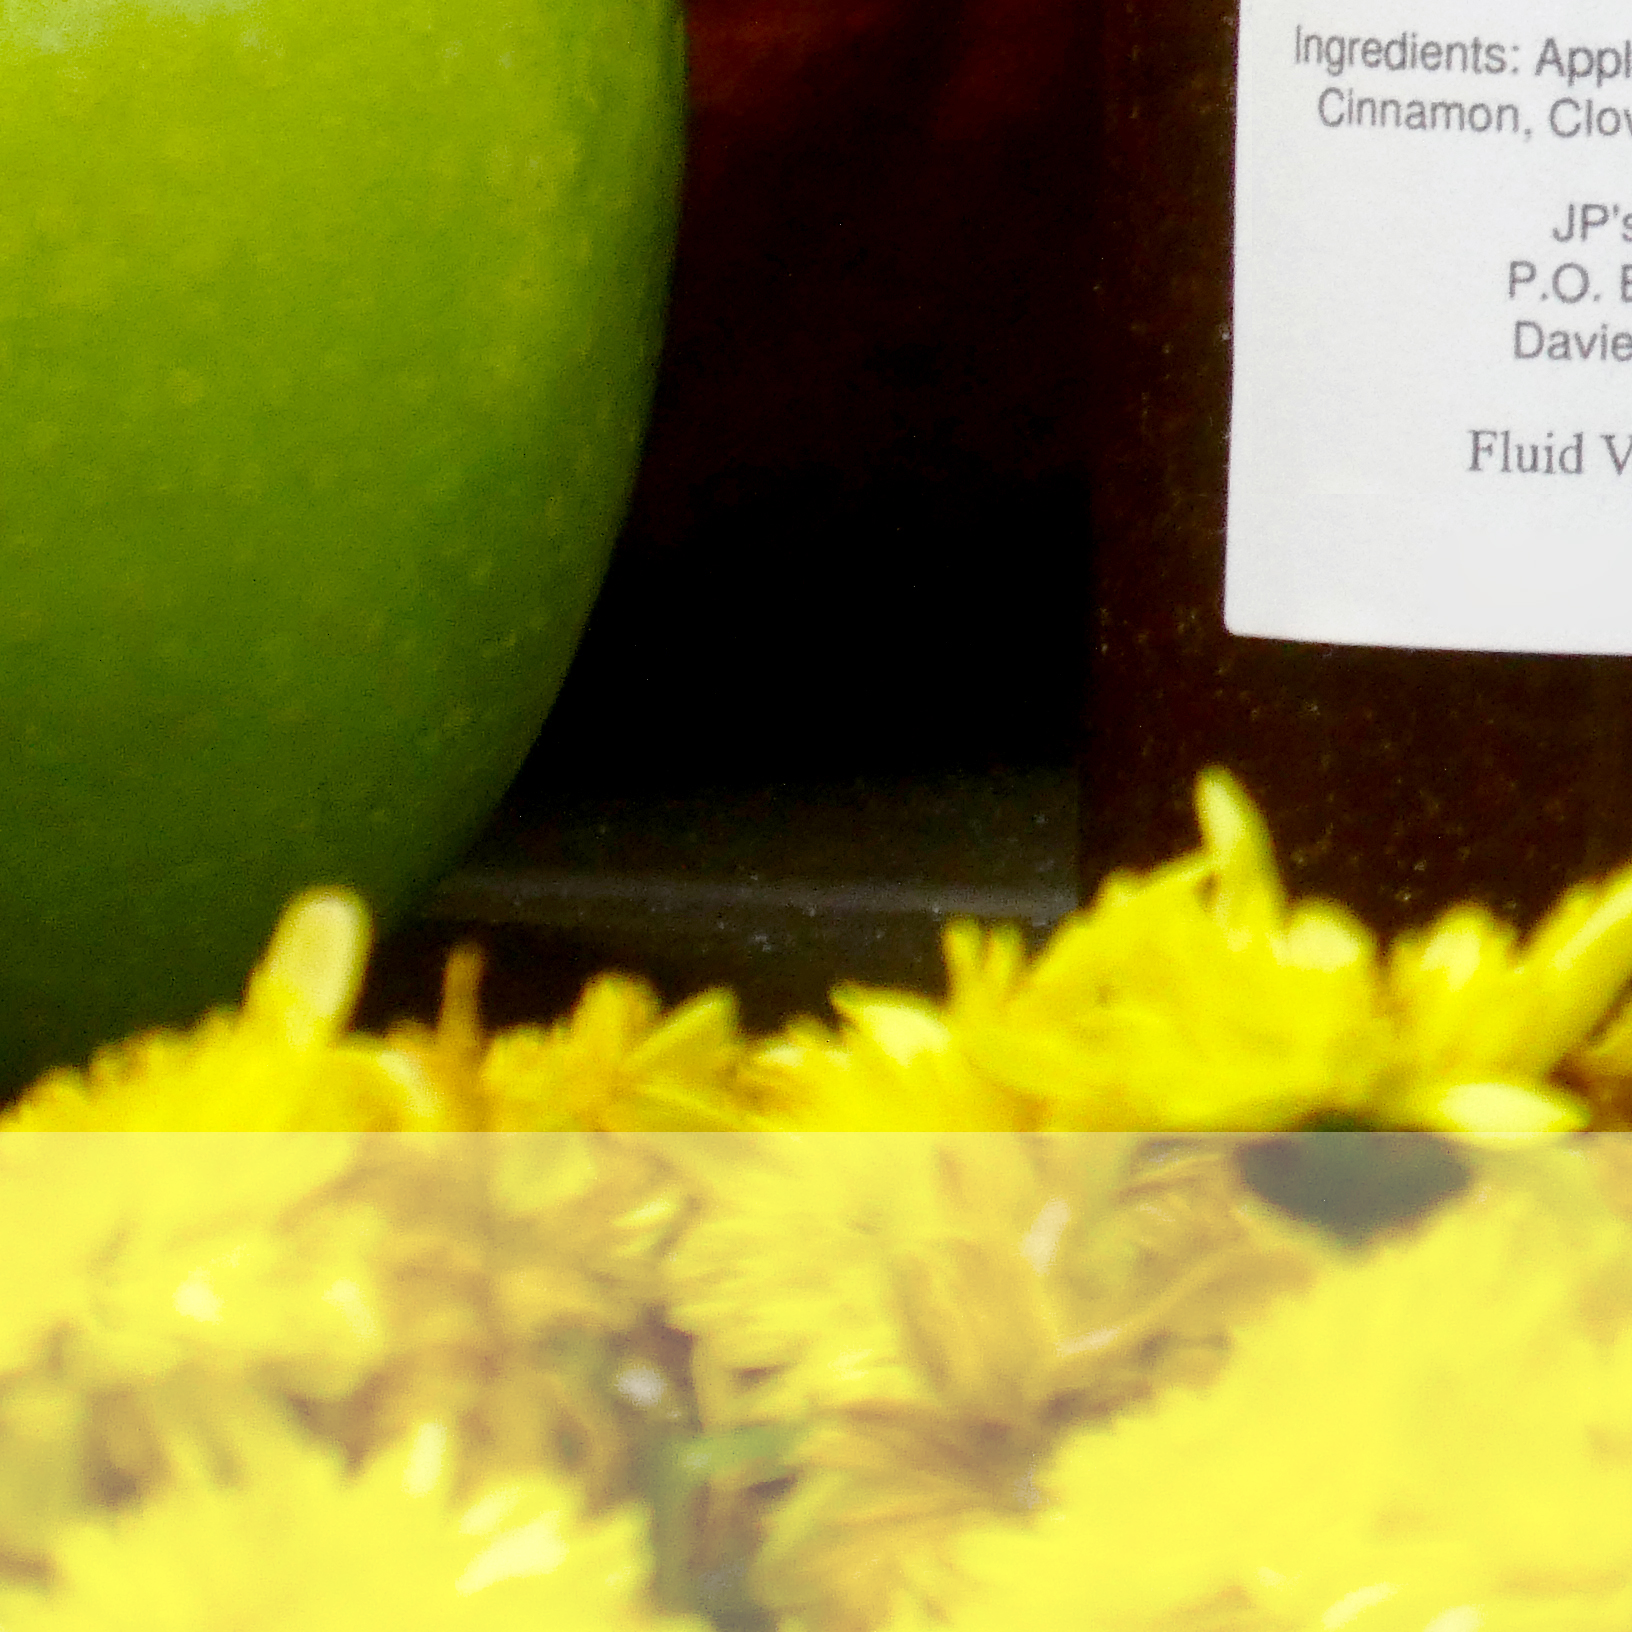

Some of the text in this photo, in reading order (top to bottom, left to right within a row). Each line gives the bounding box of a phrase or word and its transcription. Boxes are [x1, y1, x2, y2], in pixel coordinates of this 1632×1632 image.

[1296, 25, 1519, 77] Ingredients:
[1318, 87, 1531, 138] Cinnamon,
[1509, 260, 1600, 304] P.O.
[1469, 430, 1583, 474] Fluid
